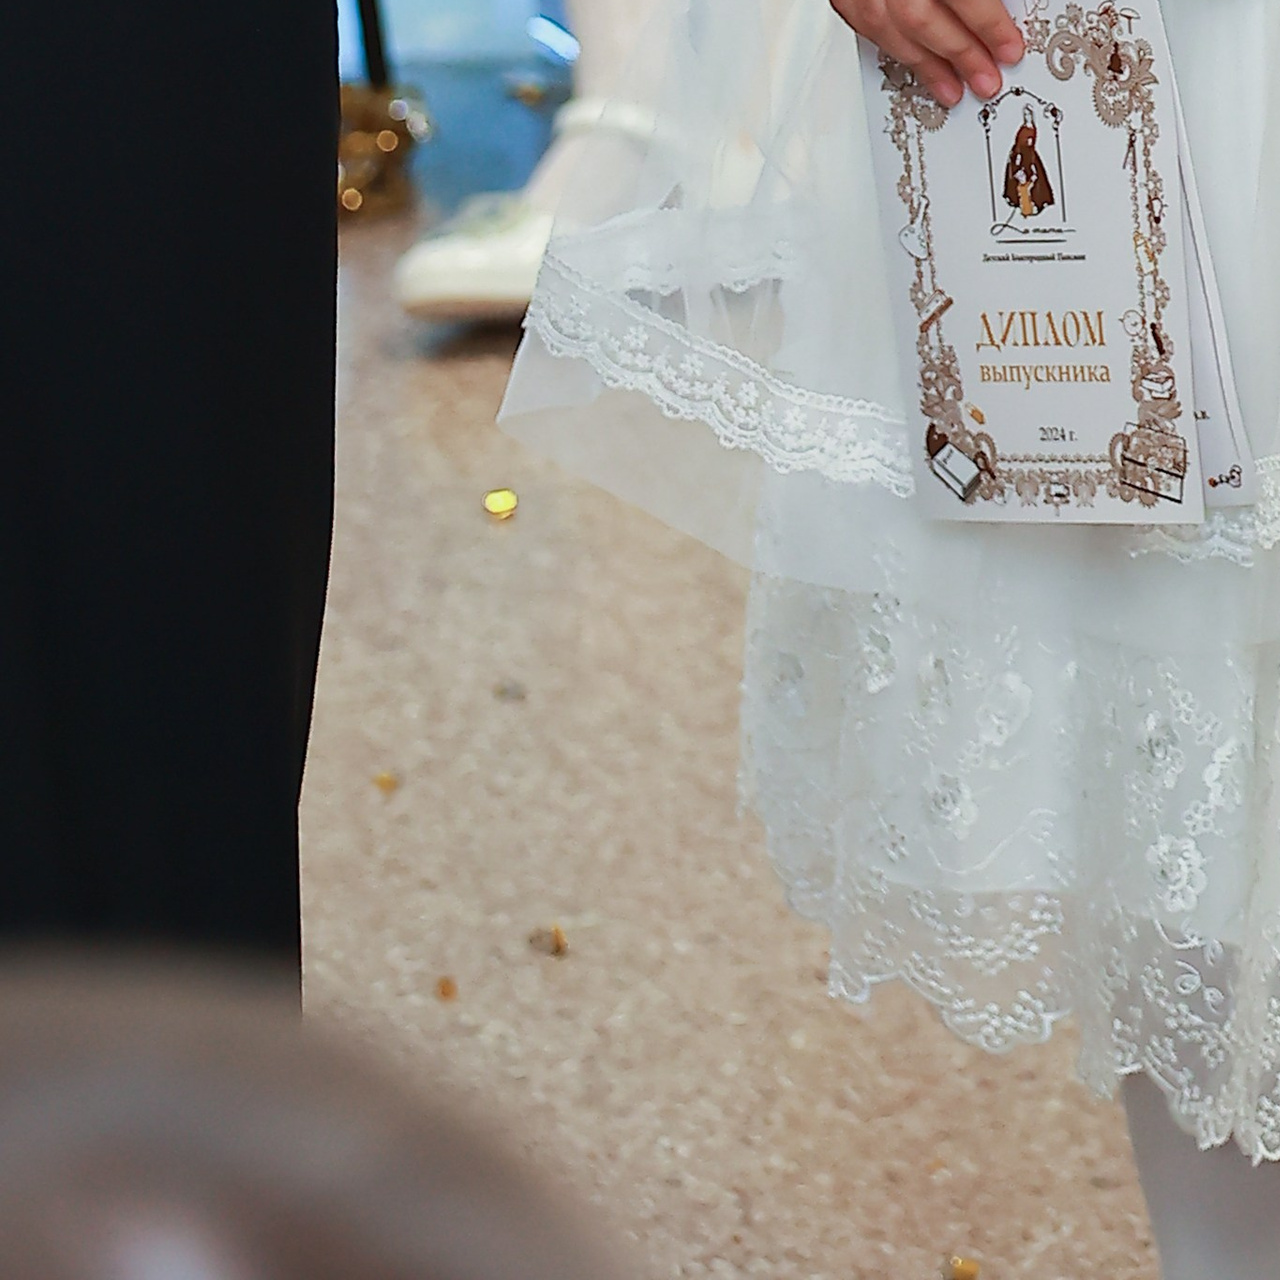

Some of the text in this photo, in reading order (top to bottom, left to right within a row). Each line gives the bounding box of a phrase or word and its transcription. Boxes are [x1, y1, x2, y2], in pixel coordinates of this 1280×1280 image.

[976, 310, 1107, 352] ДИПЛОМ
[979, 364, 1111, 390] выпускника
[1038, 426, 1067, 442] 2024
